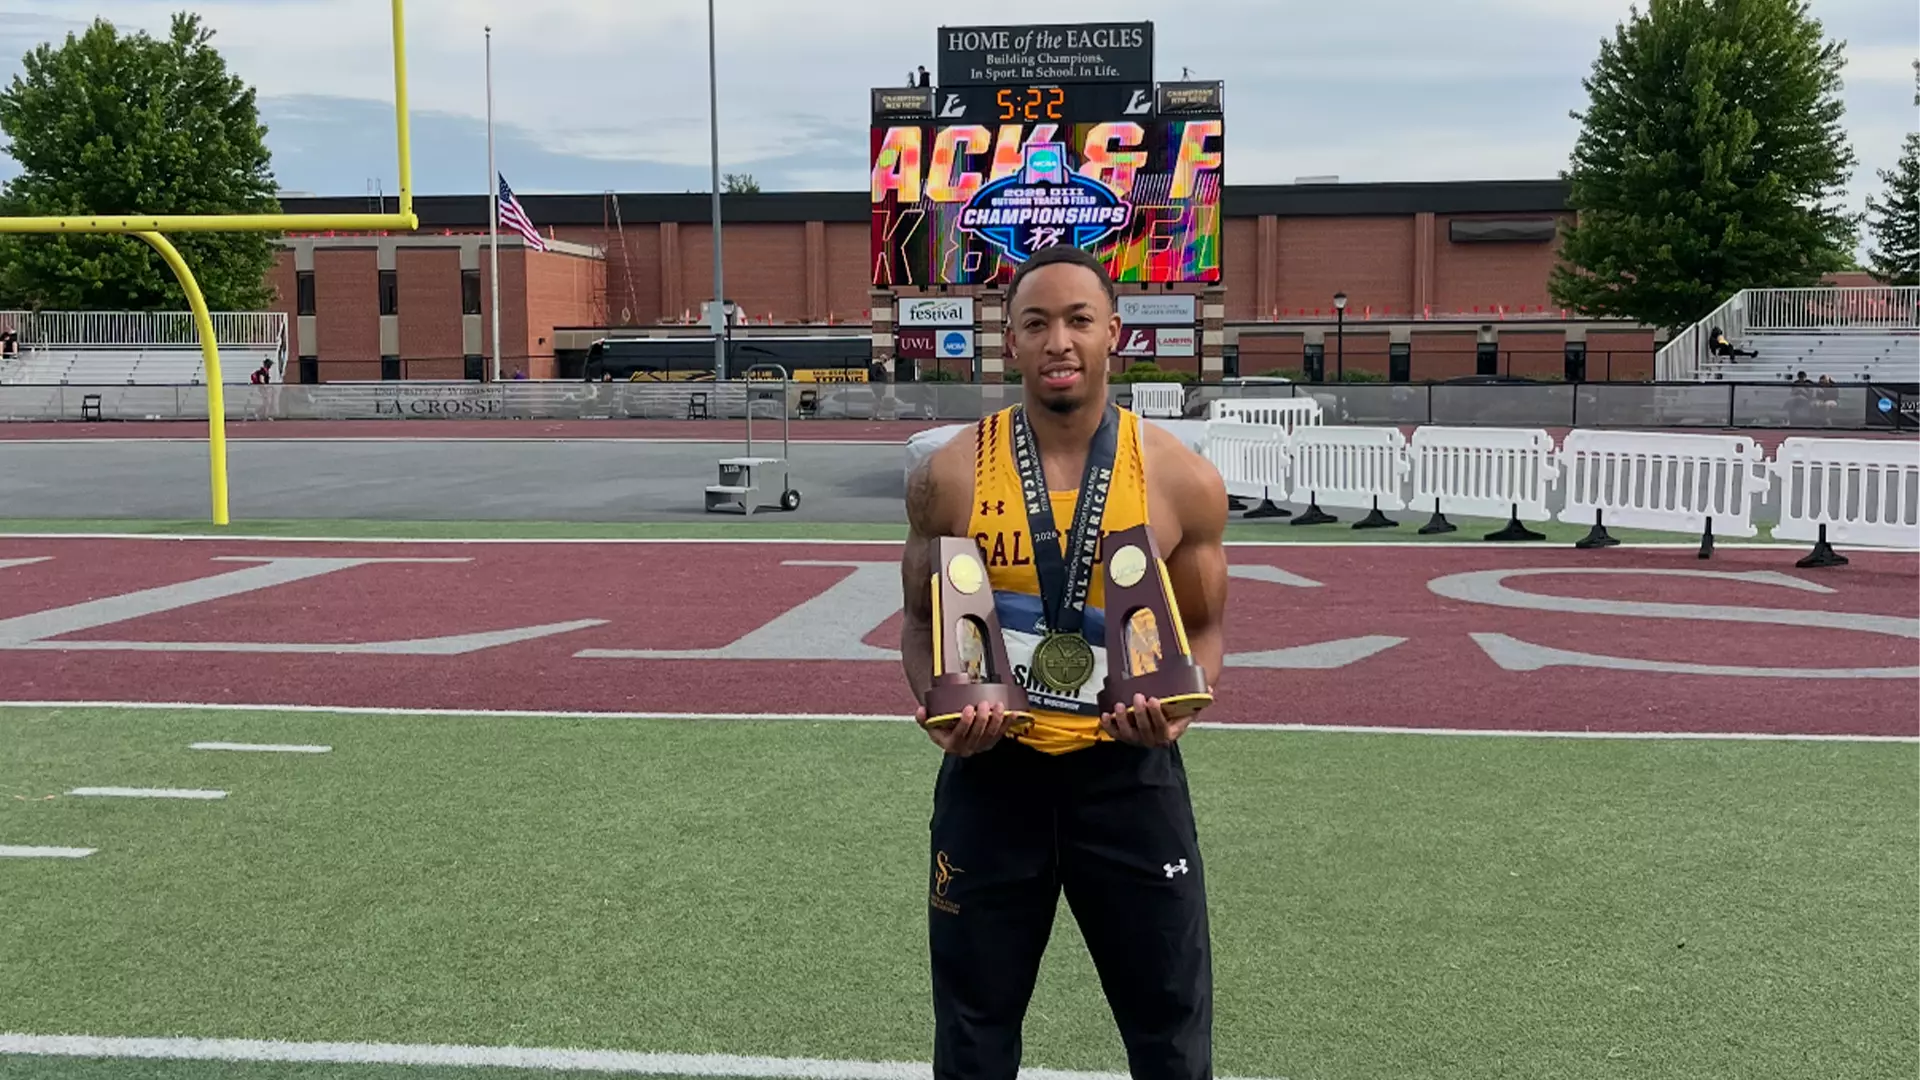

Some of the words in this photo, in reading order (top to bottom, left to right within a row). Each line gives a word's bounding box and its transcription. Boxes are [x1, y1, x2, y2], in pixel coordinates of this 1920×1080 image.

[948, 31, 1010, 51] HOME
[1014, 30, 1034, 54] of
[1036, 31, 1062, 49] the
[1067, 28, 1143, 49] EAGLES
[986, 53, 1035, 66] Building
[1037, 52, 1104, 65] Champions.
[971, 69, 983, 79] In
[985, 67, 1018, 81] Sport.
[1021, 67, 1034, 78] In
[1035, 66, 1077, 78] School.
[1080, 67, 1092, 77] In
[1094, 66, 1120, 77] Life.
[997, 89, 1065, 119] 5:22
[1033, 197, 1062, 206] TRACK
[1071, 195, 1097, 205] FIELD
[963, 206, 1125, 226] CHAMPIONSHIPS
[909, 304, 963, 322] festival
[901, 338, 934, 350] UWL
[374, 400, 404, 414] LA
[410, 399, 501, 414] CROSSE
